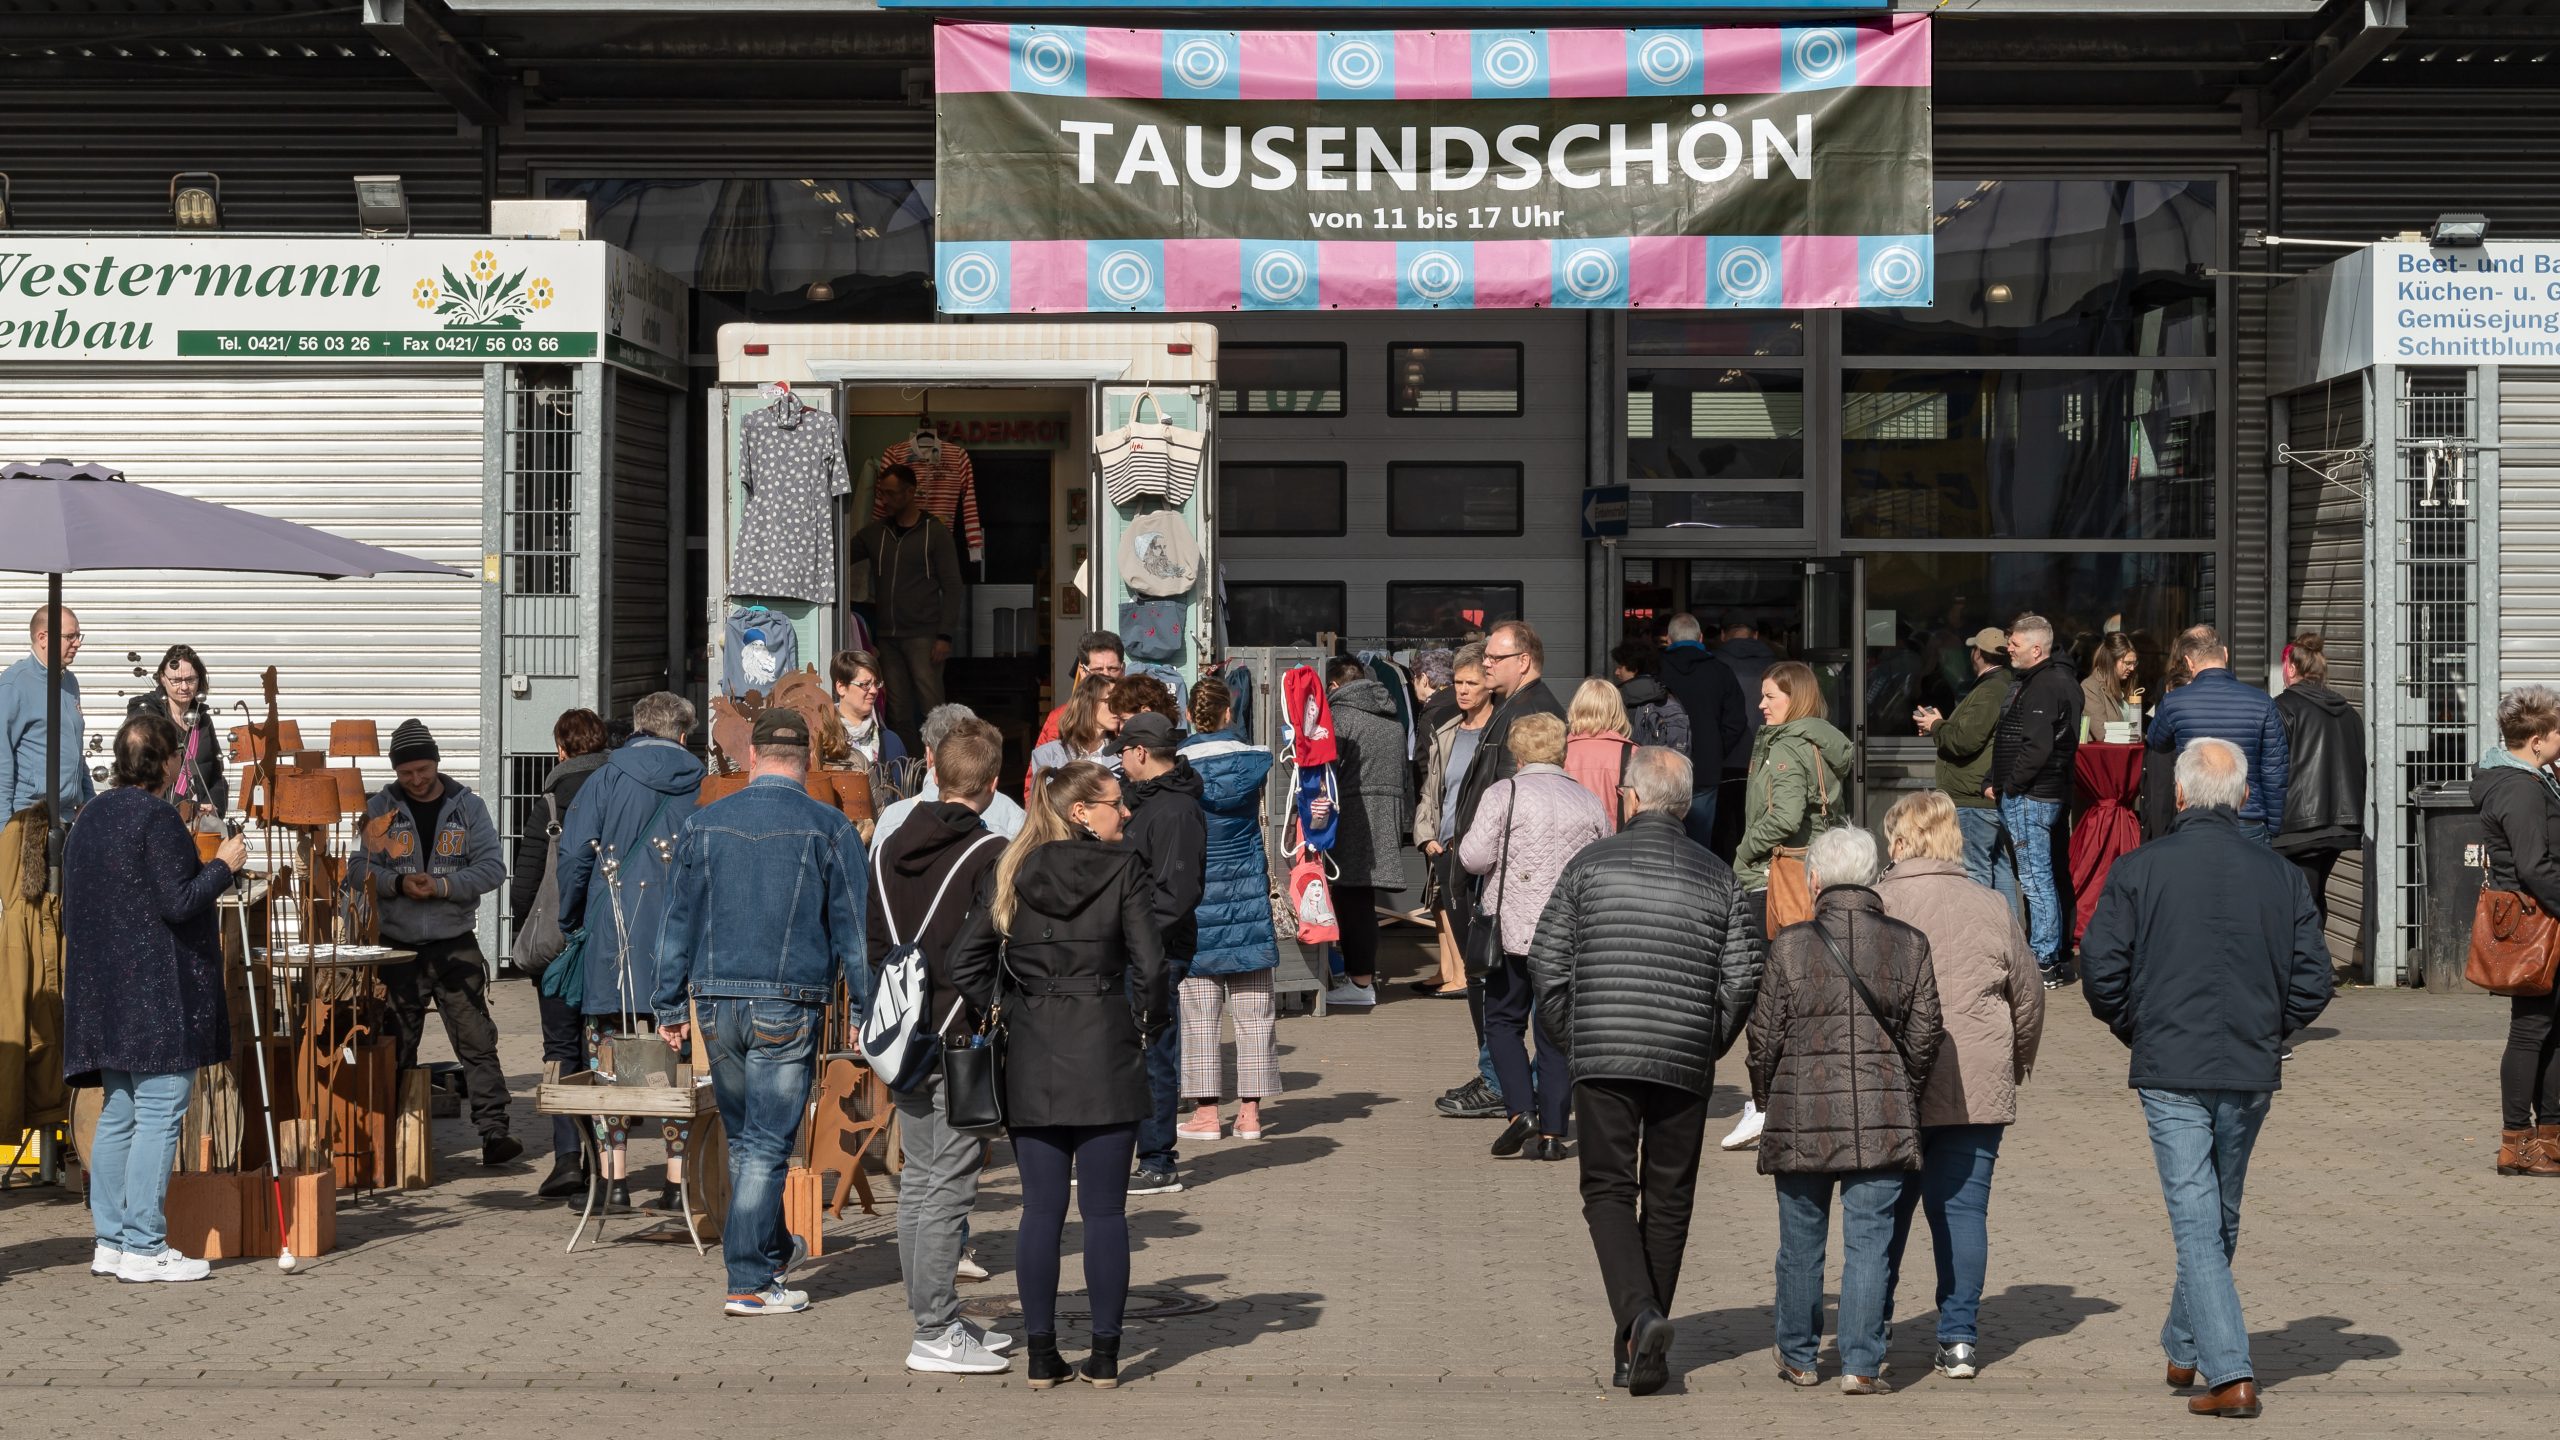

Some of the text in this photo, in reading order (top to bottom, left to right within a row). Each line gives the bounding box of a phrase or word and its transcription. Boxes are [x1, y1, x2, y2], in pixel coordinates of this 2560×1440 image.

[1060, 104, 1812, 191] TAUSENDSCHÖN
[1308, 206, 1565, 230] von 11 bis 17 Uhr
[2398, 254, 2467, 273] Beet-
[2477, 254, 2524, 273] und
[2398, 281, 2503, 301] Küchen-
[2513, 286, 2536, 301] u.
[2398, 308, 2559, 333] Gemüsejung
[217, 336, 242, 351] Tel.
[247, 335, 292, 352] 0421/
[298, 336, 319, 351] 56
[324, 336, 345, 351] 03
[350, 336, 370, 351] 26
[403, 336, 429, 351] Fax
[435, 335, 479, 352] 0421/
[485, 337, 506, 352] 56
[511, 337, 533, 352] 03
[538, 337, 559, 352] 66
[936, 419, 1069, 443] FADENROT
[391, 829, 466, 857] 9 87
[866, 948, 926, 1044] NIKE
